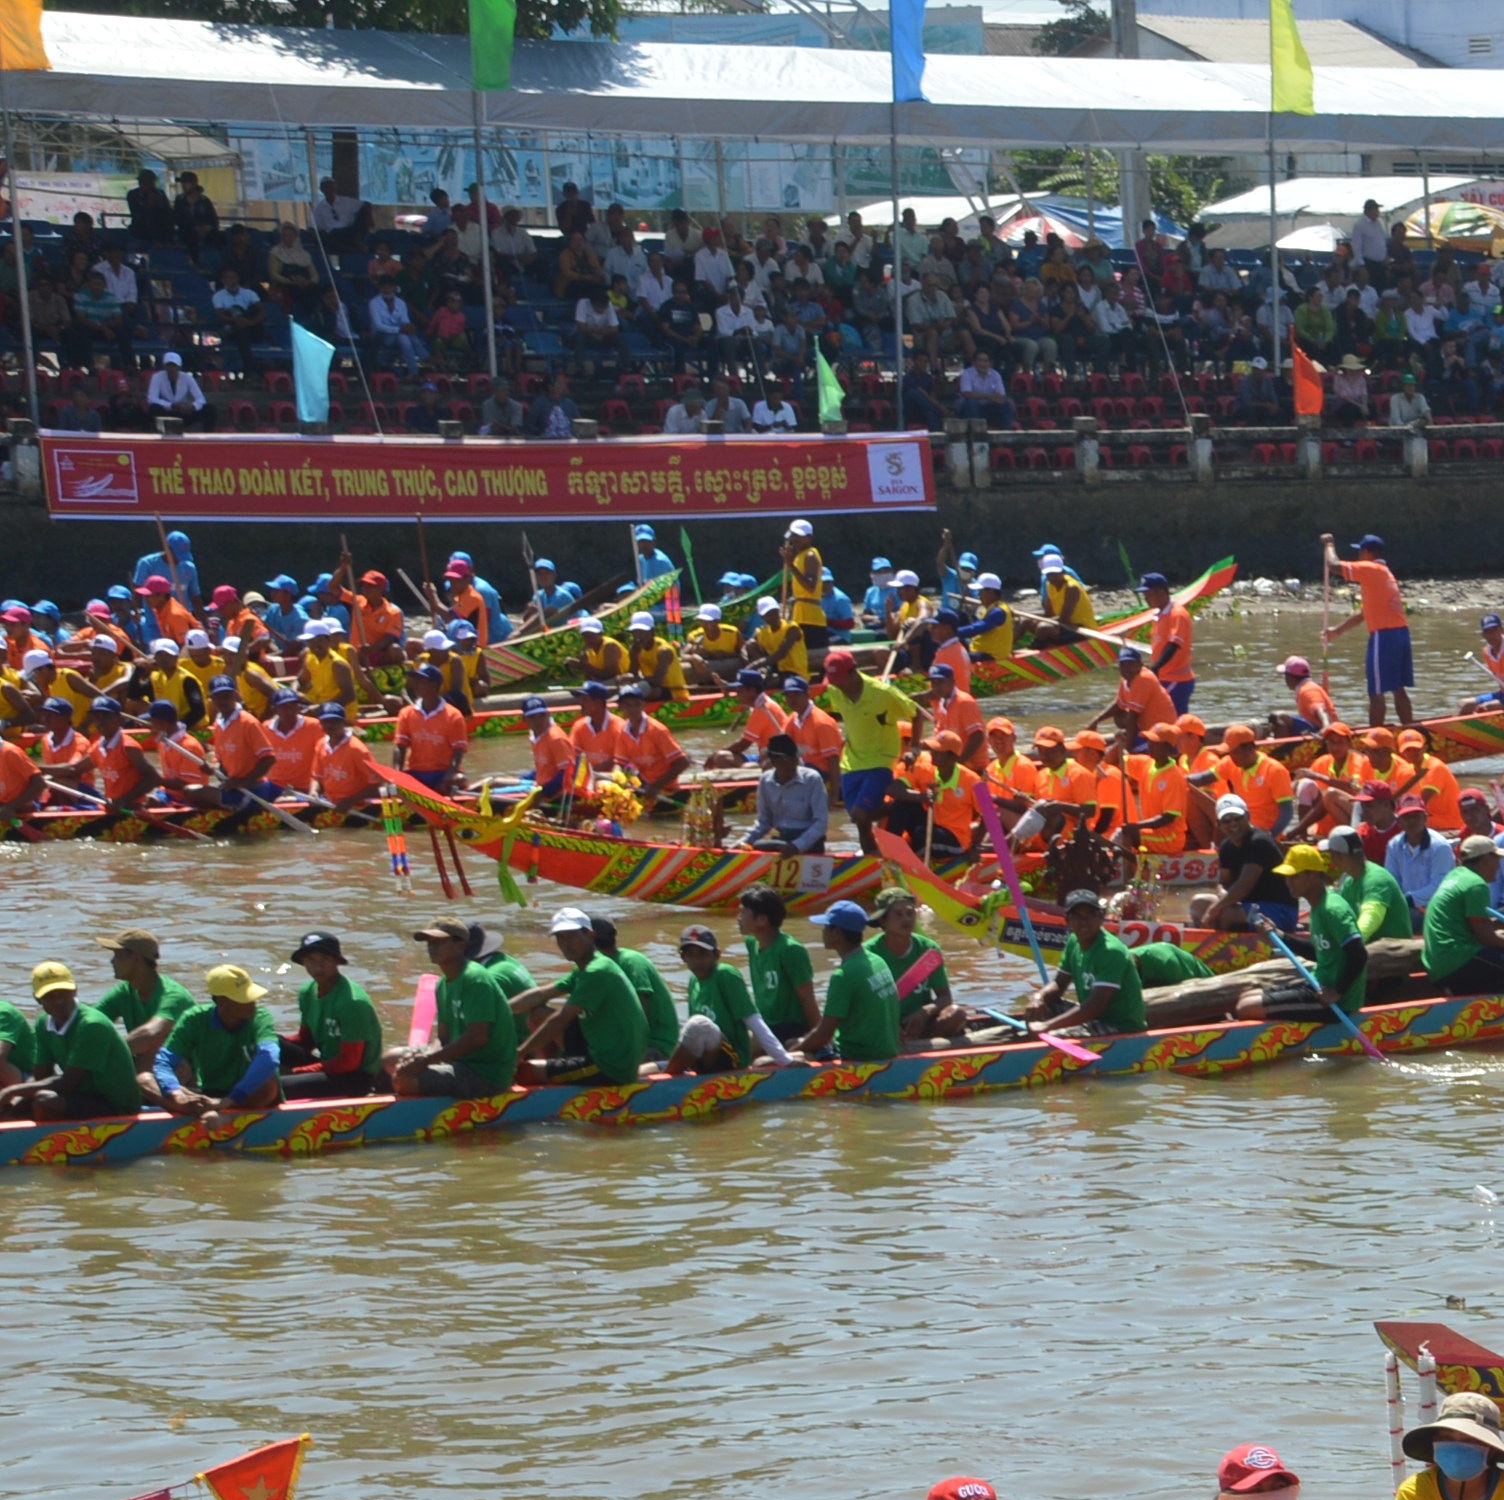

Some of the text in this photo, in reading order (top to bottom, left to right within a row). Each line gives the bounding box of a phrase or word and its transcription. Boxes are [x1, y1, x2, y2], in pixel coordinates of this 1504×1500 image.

[149, 454, 549, 505] THỂ THAO ĐOÀN KẾT, TRUNG THỰC, CAO THƯỢNG
[773, 858, 800, 889] 12
[957, 1482, 991, 1500] GUCCI
